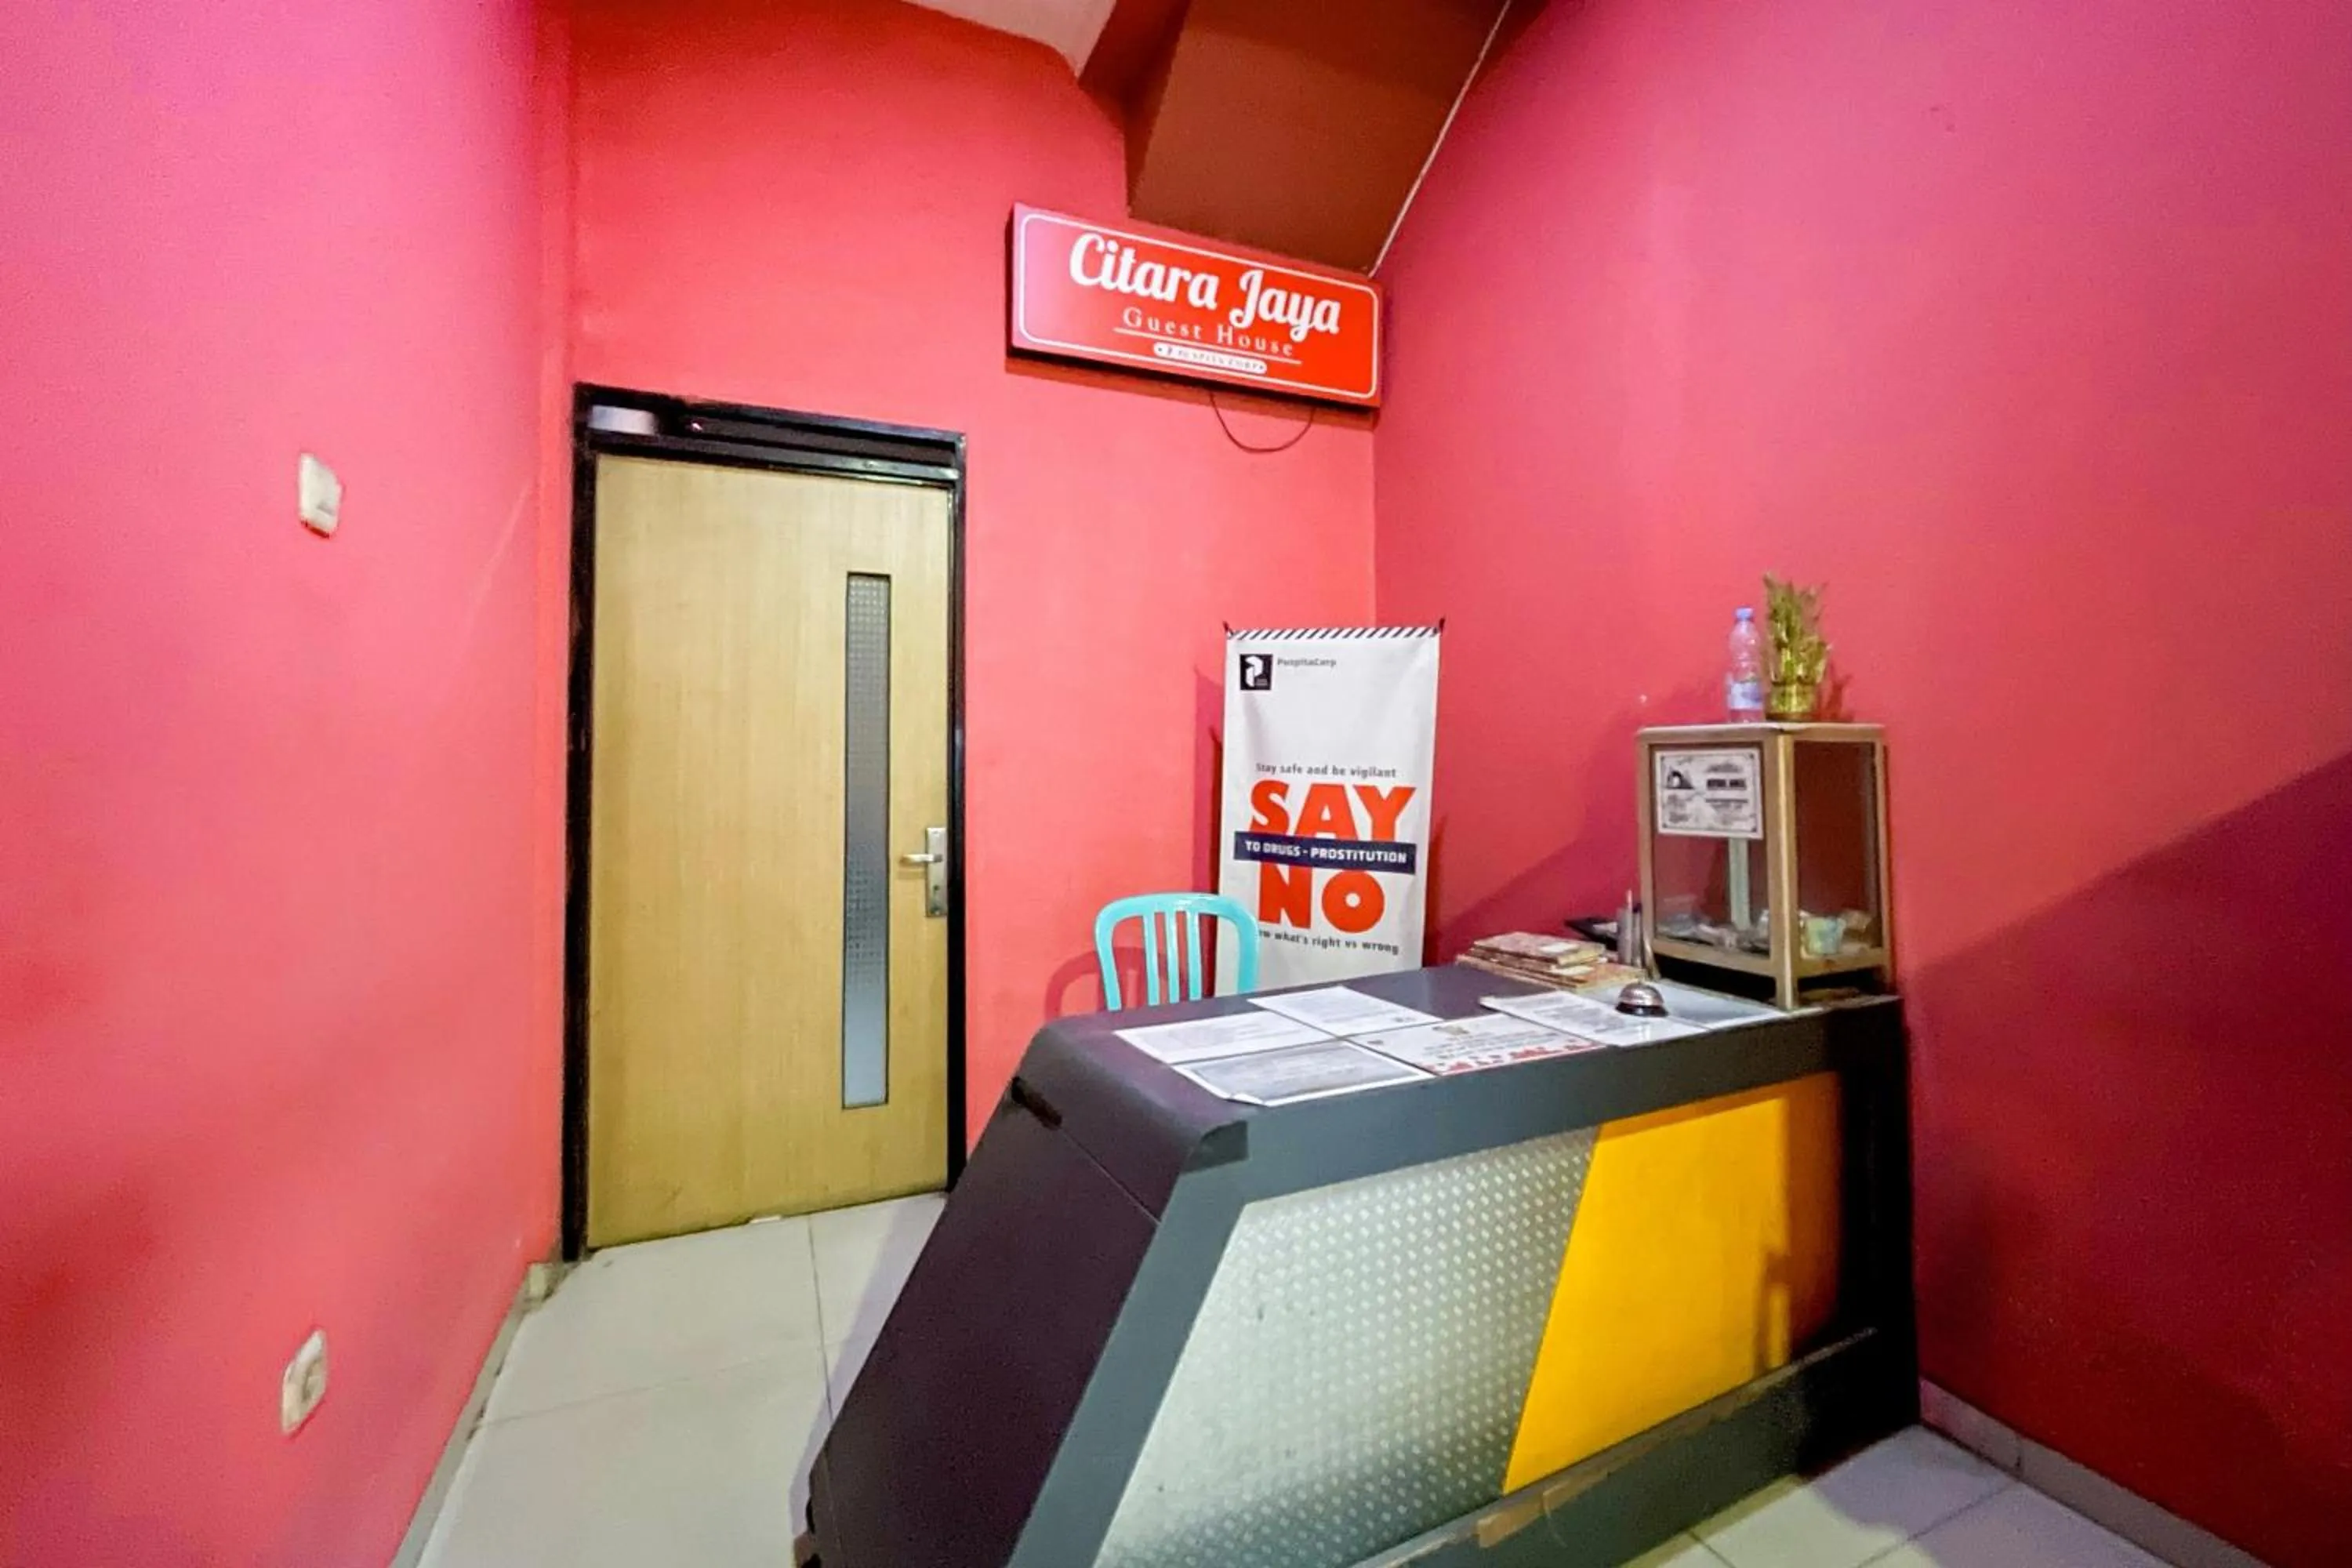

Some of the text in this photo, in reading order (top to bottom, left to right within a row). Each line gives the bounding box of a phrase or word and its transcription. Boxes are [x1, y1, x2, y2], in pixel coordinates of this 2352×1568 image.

[1069, 233, 1342, 344] Citara Jaya
[1123, 307, 1294, 357] Guest House
[1256, 763, 1396, 779] Stay safe and be vigilant
[1250, 779, 1416, 841] SAY
[1245, 840, 1261, 852] TO
[1263, 842, 1301, 857] DRUGS
[1310, 848, 1407, 864] PROSTITUTION
[1259, 861, 1385, 934] NO
[1275, 931, 1308, 946] what's
[1312, 937, 1341, 949] right
[1362, 942, 1400, 956] wrong
